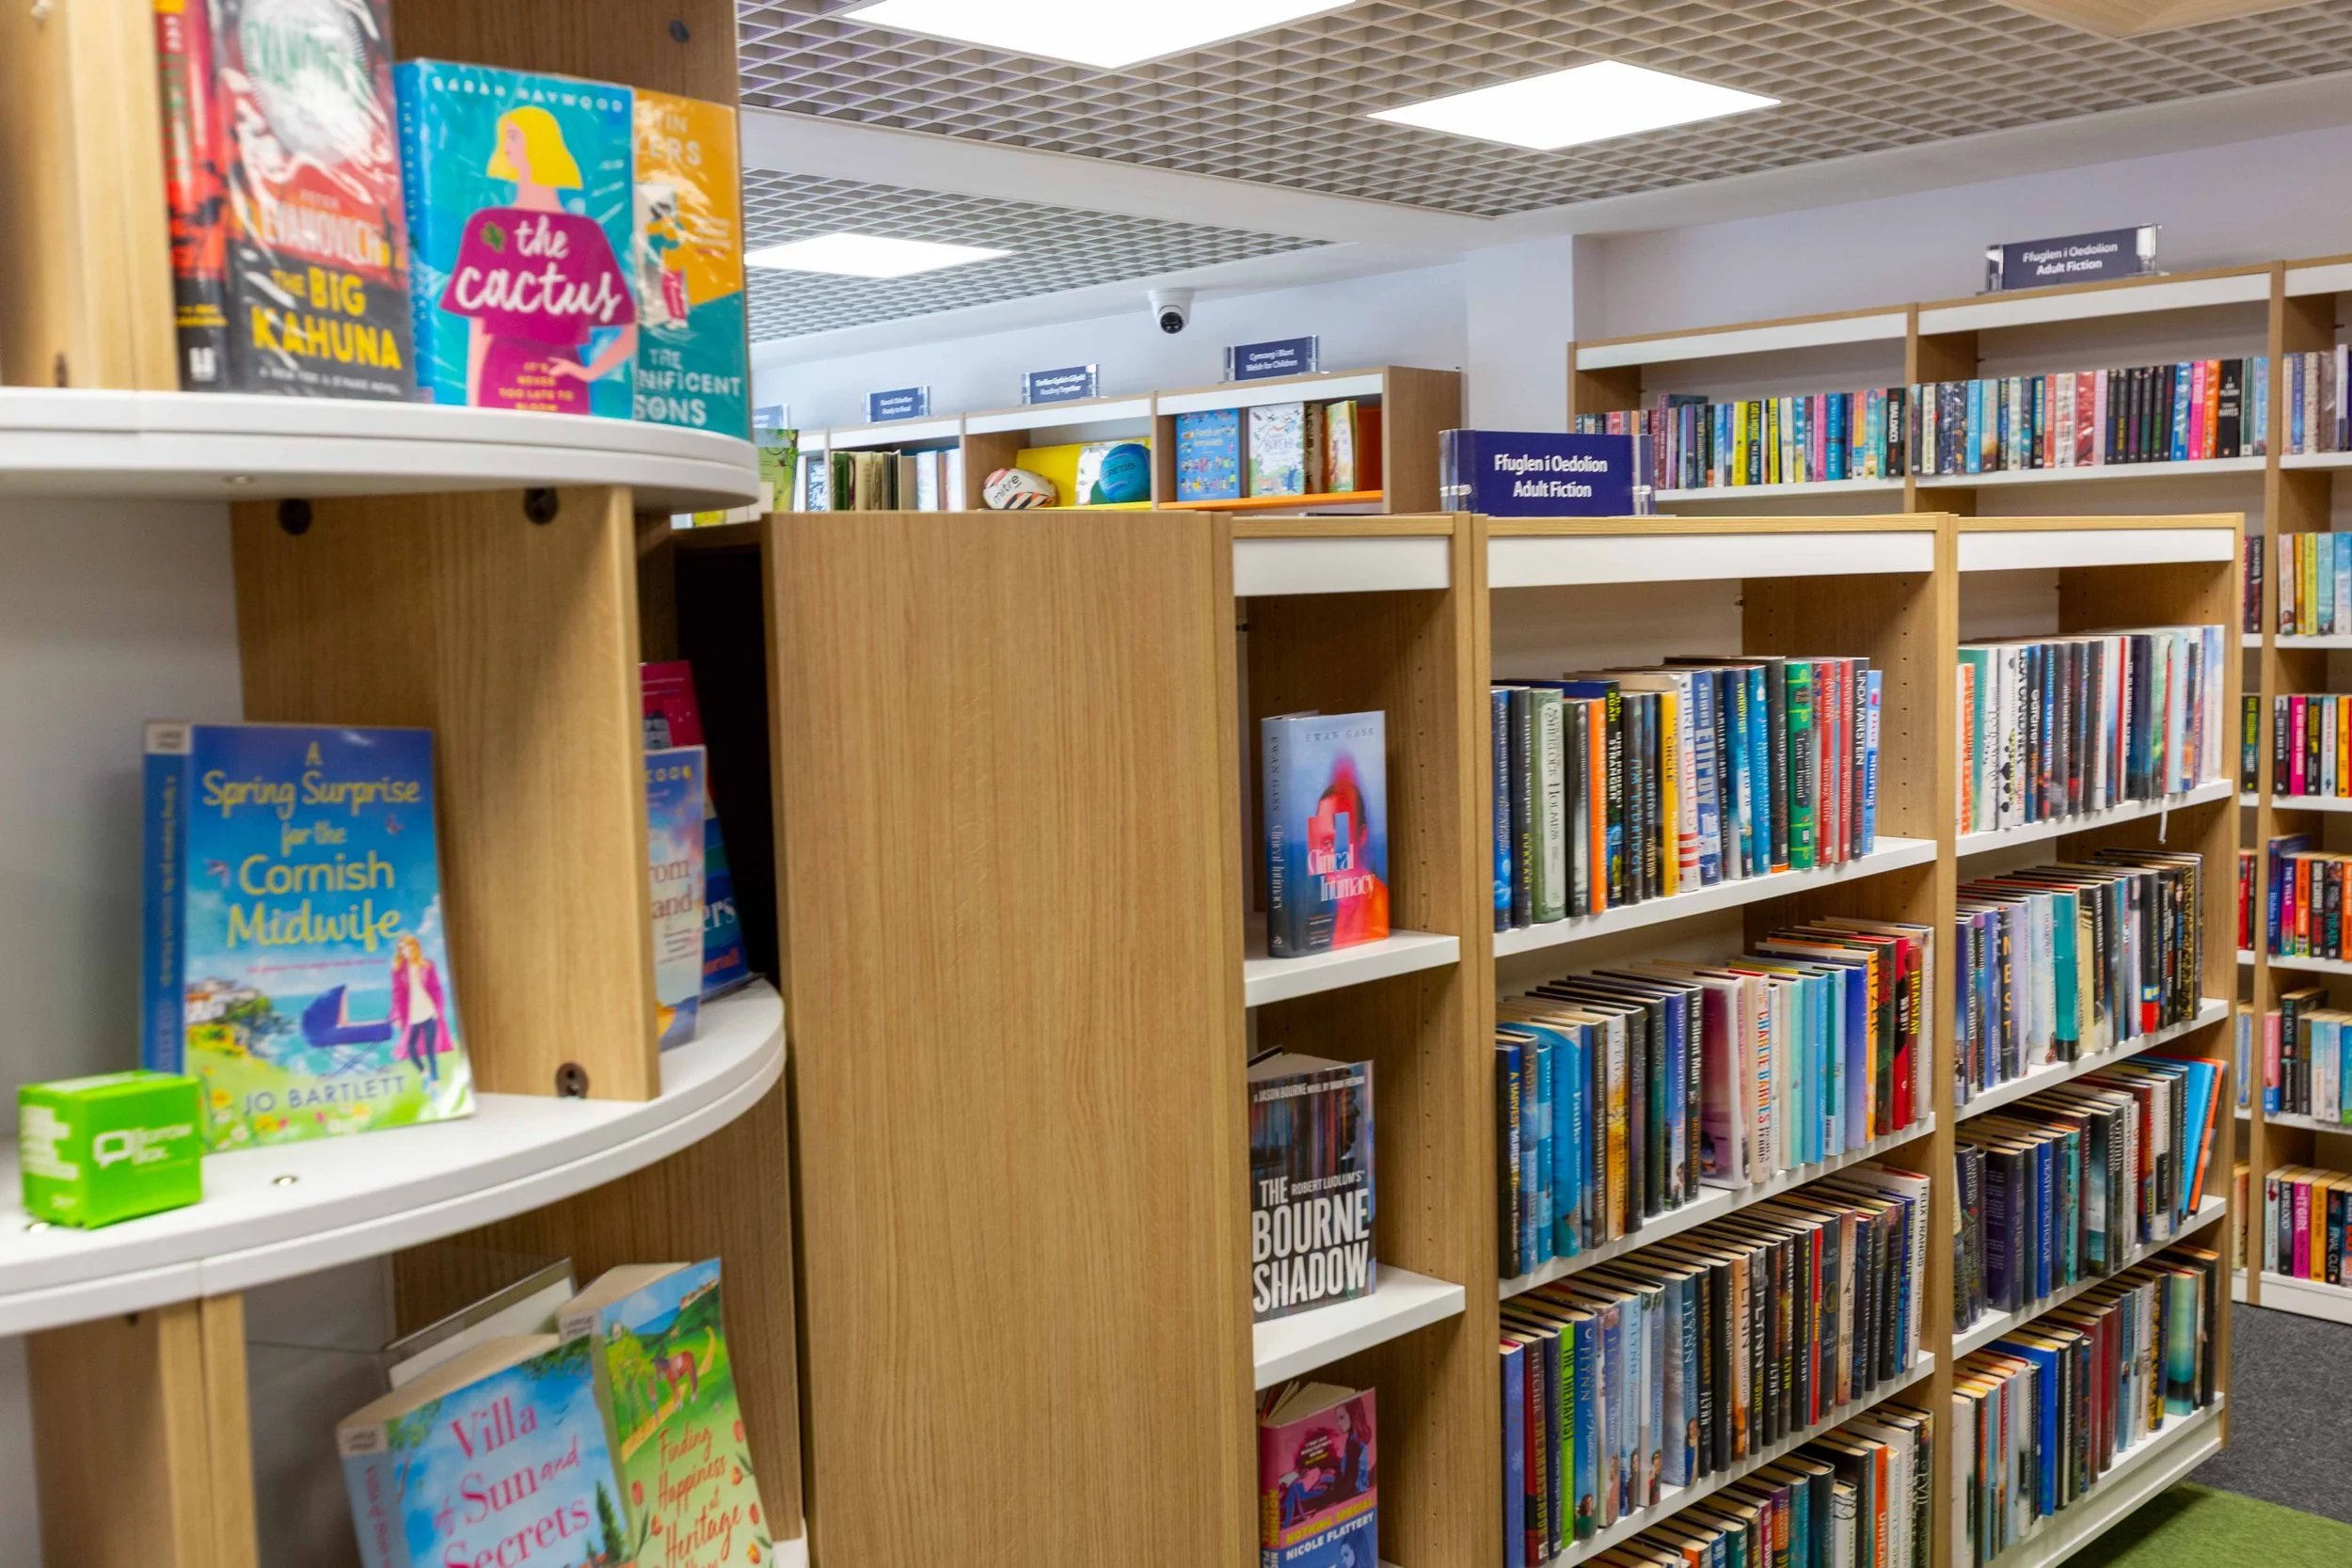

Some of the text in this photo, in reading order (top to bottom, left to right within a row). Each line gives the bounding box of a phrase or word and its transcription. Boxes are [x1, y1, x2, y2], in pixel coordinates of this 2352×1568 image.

[514, 214, 569, 259] the
[2023, 250, 2062, 264] Ffuglen
[2069, 243, 2118, 256] Oedolion
[308, 266, 366, 317] BIG
[455, 260, 624, 324] cactus
[2036, 260, 2103, 277] Adult Fiction
[250, 305, 403, 372] KAHUNA
[1246, 363, 1263, 372] Welsh
[1273, 359, 1297, 368] Children
[993, 474, 1021, 505] mitre
[1494, 453, 1608, 475] Ffuglen i Oedolion
[1513, 480, 1592, 498] Adult Fiction
[1737, 682, 1748, 733] EVANOVICH
[1857, 669, 1867, 705] LINDA
[2017, 648, 2027, 764] LISA GARDNER
[1305, 726, 1375, 743] EWAN GASS
[1854, 706, 1865, 766] FAIRSTEIN
[2030, 689, 2041, 745] Gardner
[305, 740, 324, 767] A
[1695, 683, 1716, 809] James Ellroy
[1796, 737, 1805, 799] Lost Found
[201, 769, 421, 821] Spring Surprise
[1548, 782, 1562, 841] HOLMES
[1630, 758, 1641, 876] JIM ELDRIDGE
[280, 820, 348, 858] for the
[1307, 843, 1355, 876] Clinical
[239, 849, 396, 895] Cornish
[1271, 825, 1285, 911] Clinical Intimacy
[1320, 872, 1376, 903] Intimacy
[2284, 866, 2294, 906] THE VILLA
[226, 897, 402, 955] Midwife
[1692, 996, 1702, 1019] The
[1909, 970, 1921, 1035] FREAKSLAW
[2002, 936, 2012, 1039] NEST
[1692, 1020, 1702, 1055] Silent
[2284, 1000, 2294, 1042] THE HOME
[1677, 1003, 1686, 1107] Mother's Heartbreak
[1691, 1058, 1702, 1085] Man
[1756, 1010, 1770, 1124] CHARLIE BARNES
[243, 1075, 406, 1117] JO BARTLETT
[1258, 1086, 1280, 1102] JASON
[1280, 1083, 1307, 1100] BOURNE
[1509, 1083, 1519, 1130] HARVEST
[1572, 1091, 1582, 1145] Faulks
[1509, 1130, 1519, 1174] MURDER
[1756, 1128, 1766, 1164] FERRIS
[2113, 1118, 2124, 1172] Griffiths
[1259, 1176, 1323, 1209] THE ROBERT
[2042, 1158, 2052, 1263] DEATH SCHOLAR
[1252, 1188, 1370, 1263] BOURNE
[1917, 1186, 1928, 1268] FELIX FRANCIS
[2296, 1208, 2308, 1232] GIRL
[2328, 1227, 2341, 1274] FINAL CUT
[1252, 1240, 1370, 1313] SHADOW
[1702, 1277, 1711, 1334] LETHAL
[1755, 1291, 1766, 1370] FLYNN
[1629, 1322, 1639, 1375] FLYNN
[1683, 1301, 1694, 1364] FLYNN
[1532, 1351, 1543, 1414] FLETCHER
[1563, 1347, 1575, 1442] THE THERAPIST
[1581, 1346, 1592, 1402] FLYNN
[1770, 1362, 1778, 1396] FLYNN
[1783, 1355, 1791, 1389] FLYNN
[450, 1394, 539, 1461] Villa
[1536, 1420, 1548, 1445] THE
[1700, 1391, 1710, 1426] FLYNN
[460, 1433, 581, 1525] Sun and
[657, 1452, 727, 1519] Happiness
[433, 1495, 456, 1540] of
[443, 1494, 591, 1568] Secrets
[663, 1503, 744, 1567] Heritage
[1285, 1514, 1334, 1544] NOTHING
[1285, 1512, 1375, 1561] NICOLE FLATTERY
